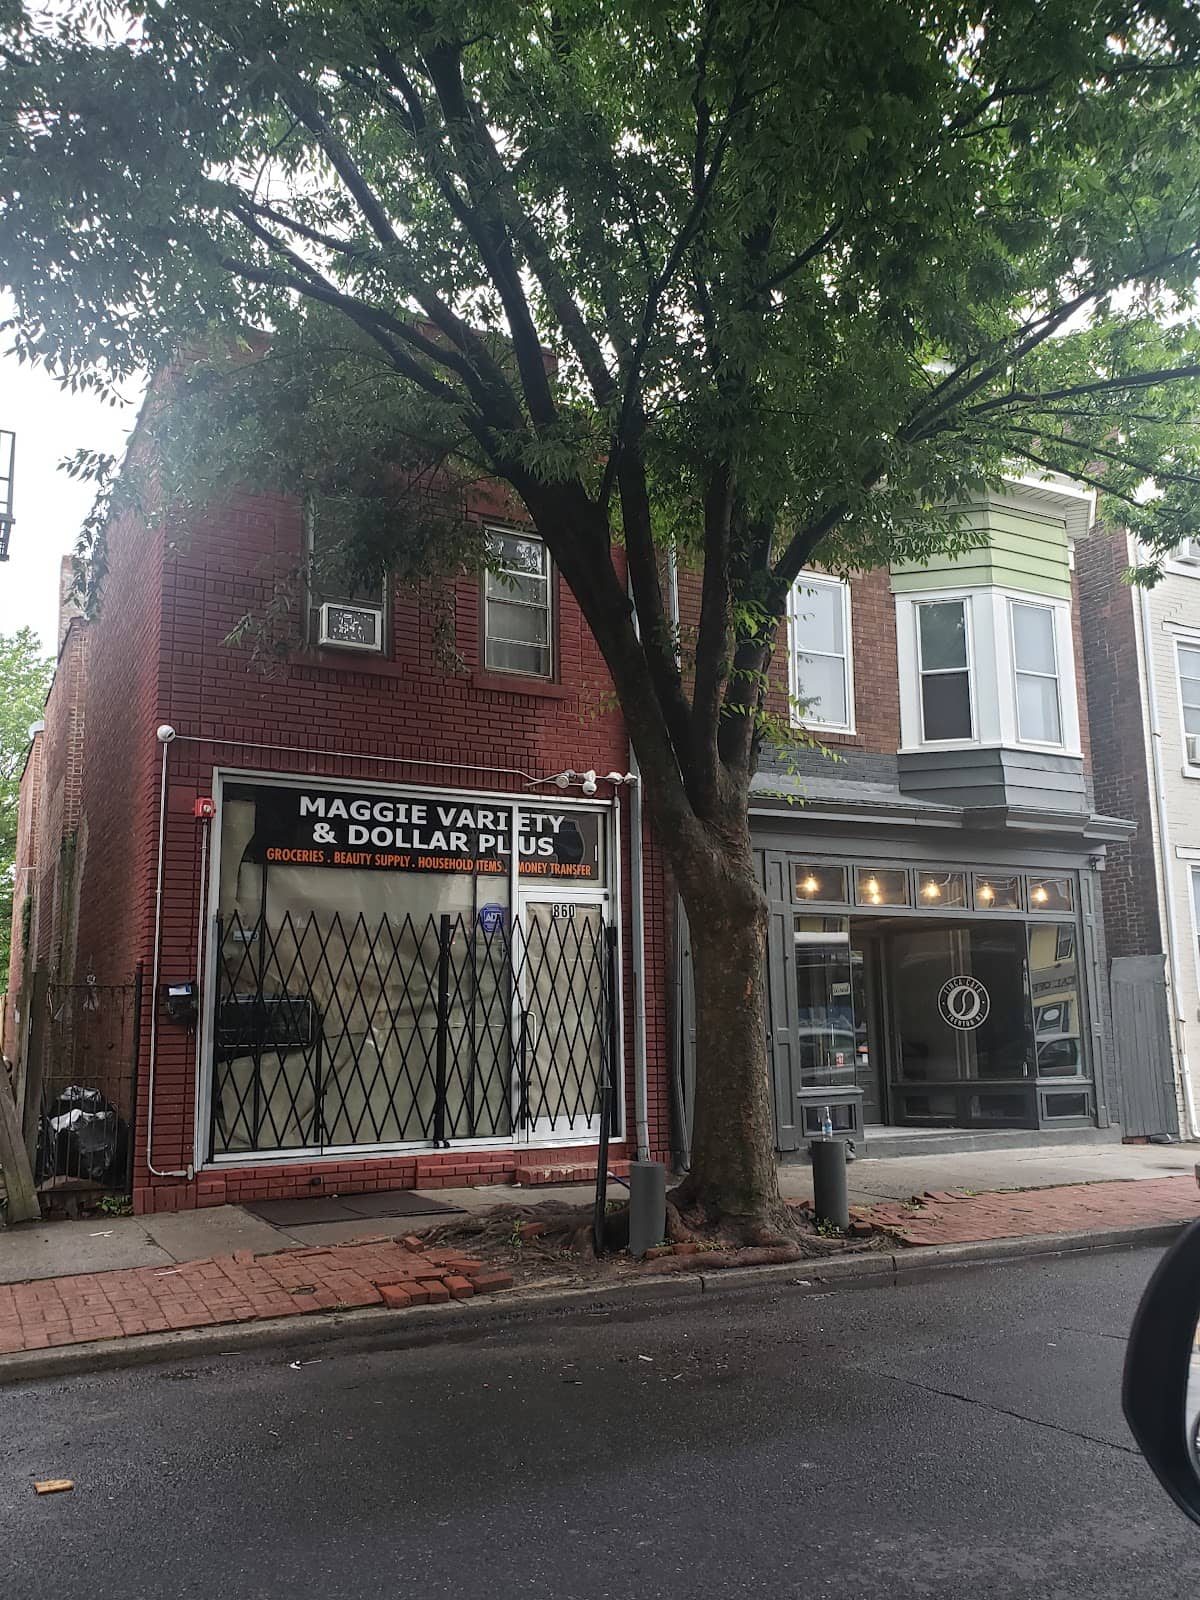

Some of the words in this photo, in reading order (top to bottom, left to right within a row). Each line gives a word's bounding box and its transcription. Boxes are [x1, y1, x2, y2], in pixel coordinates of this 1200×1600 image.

[300, 795, 427, 825] MAGGIE
[436, 806, 565, 834] VARIETY
[312, 822, 338, 844] &
[348, 824, 470, 852] DOLLAR
[478, 833, 554, 856] PLUS
[266, 847, 324, 863] GROCERIES
[333, 851, 373, 865] BEAUTY
[374, 853, 411, 868] SUPPLY
[418, 856, 474, 872] HOUSEHOLD
[475, 859, 503, 873] ITEMS
[518, 861, 548, 874] MONEY
[549, 863, 592, 876] TRANSFER
[553, 904, 575, 918] 860
